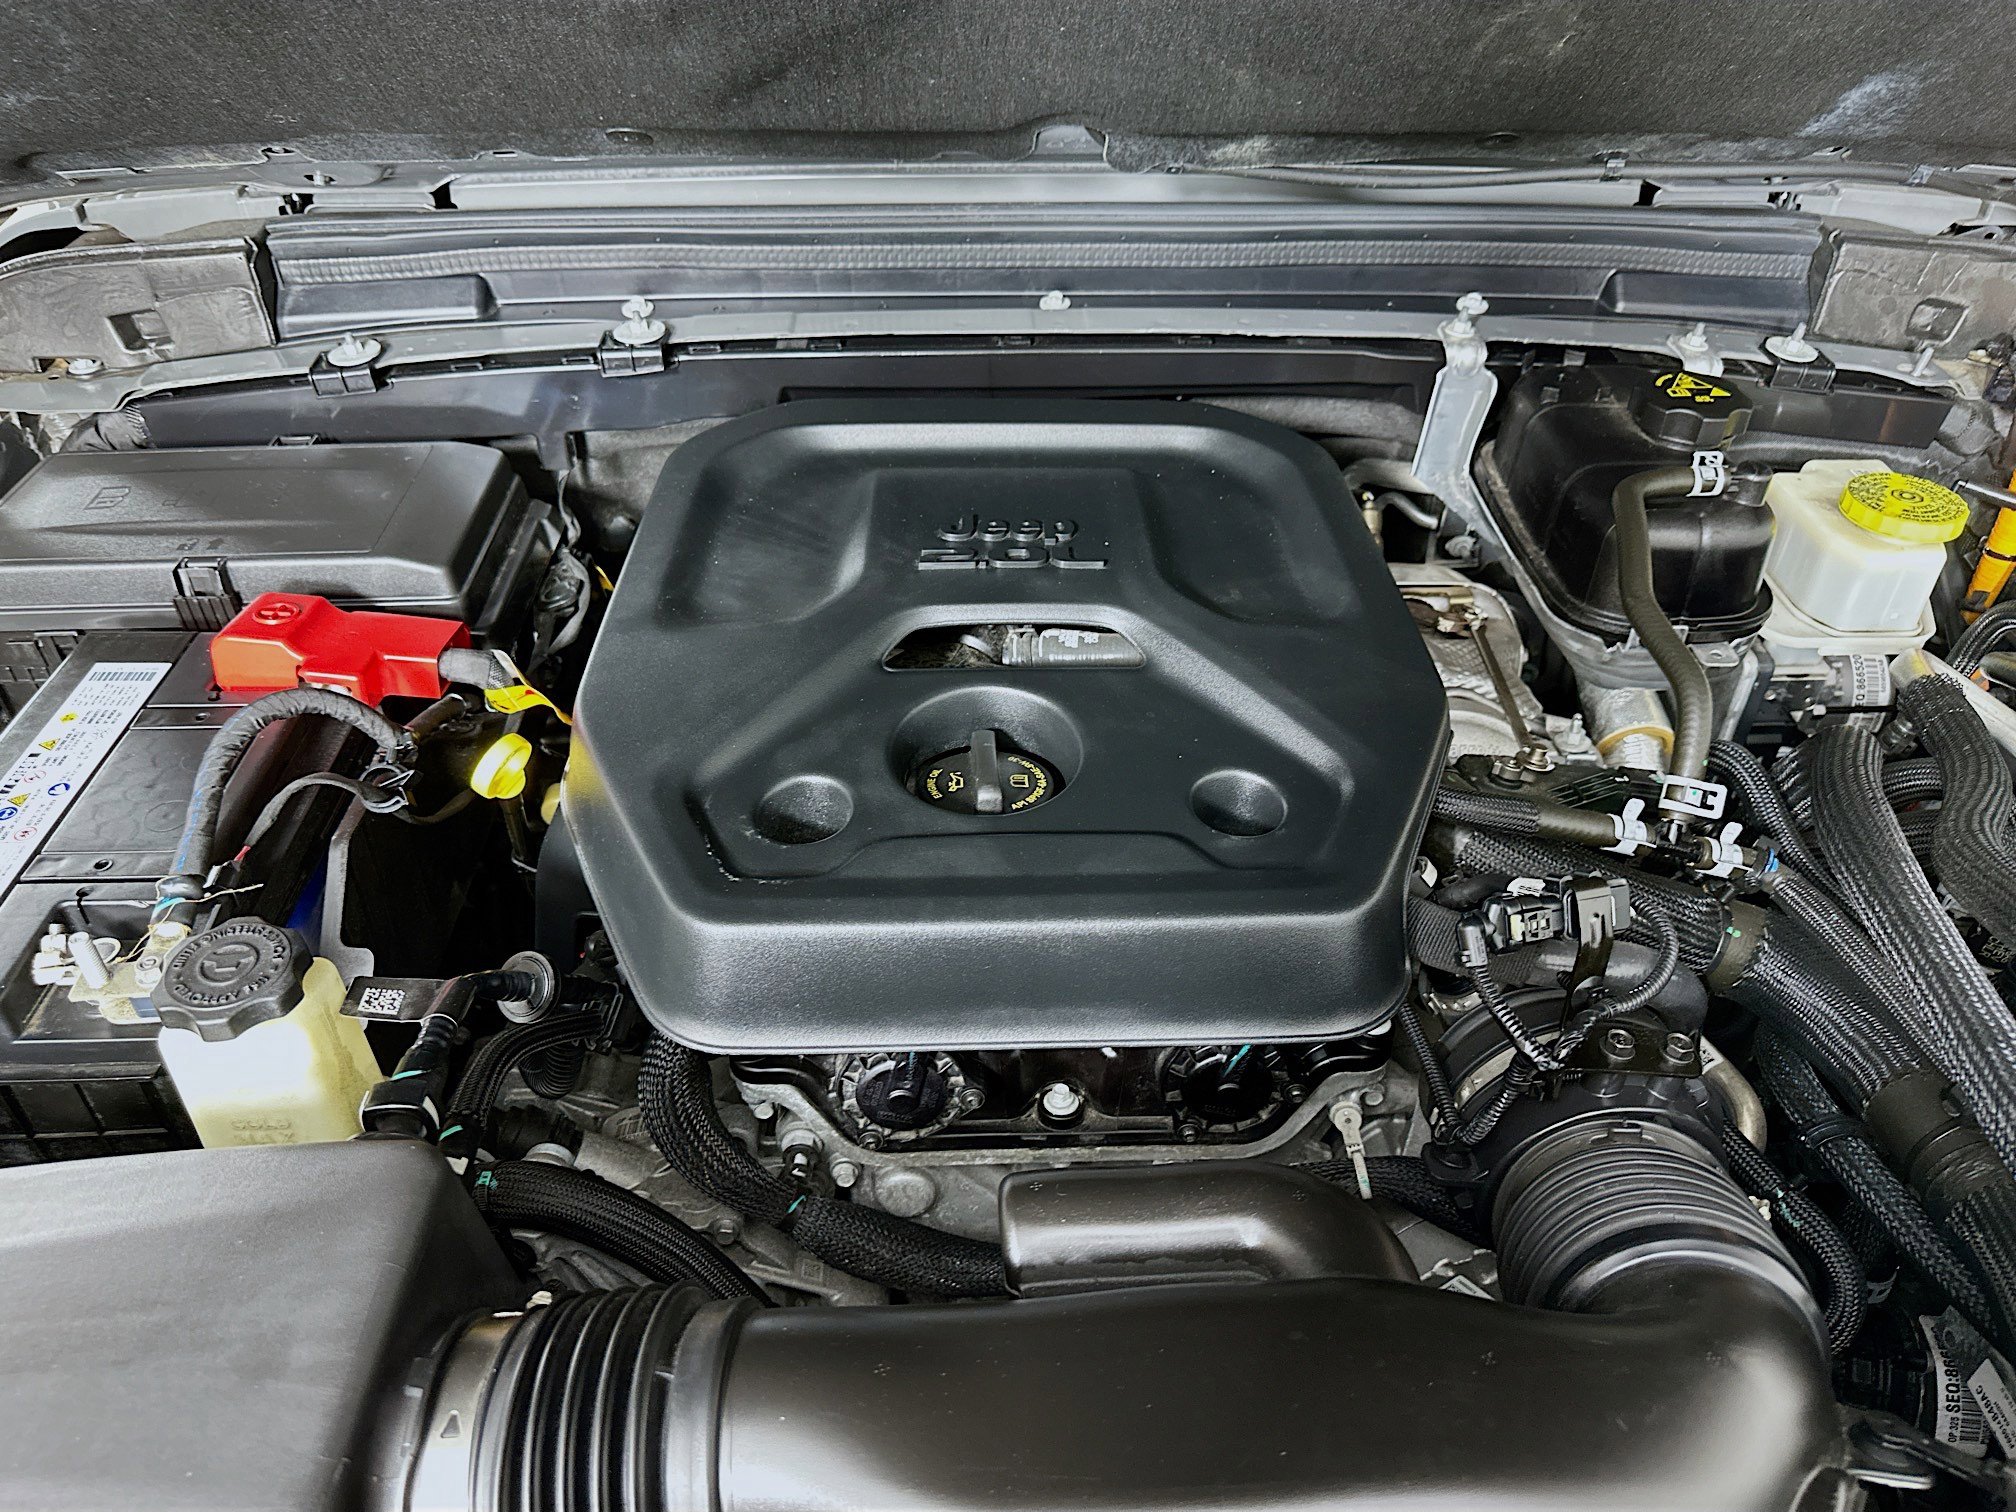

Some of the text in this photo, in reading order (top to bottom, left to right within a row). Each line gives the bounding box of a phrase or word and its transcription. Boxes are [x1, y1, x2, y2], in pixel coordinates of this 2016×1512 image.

[937, 514, 1079, 546] Jeep
[917, 548, 1108, 570] 2.0L
[926, 777, 943, 799] ENGINE
[1011, 800, 1029, 810] API
[200, 925, 265, 947] STEERING
[172, 942, 200, 969] FLUID
[173, 983, 241, 1004] APPROVED
